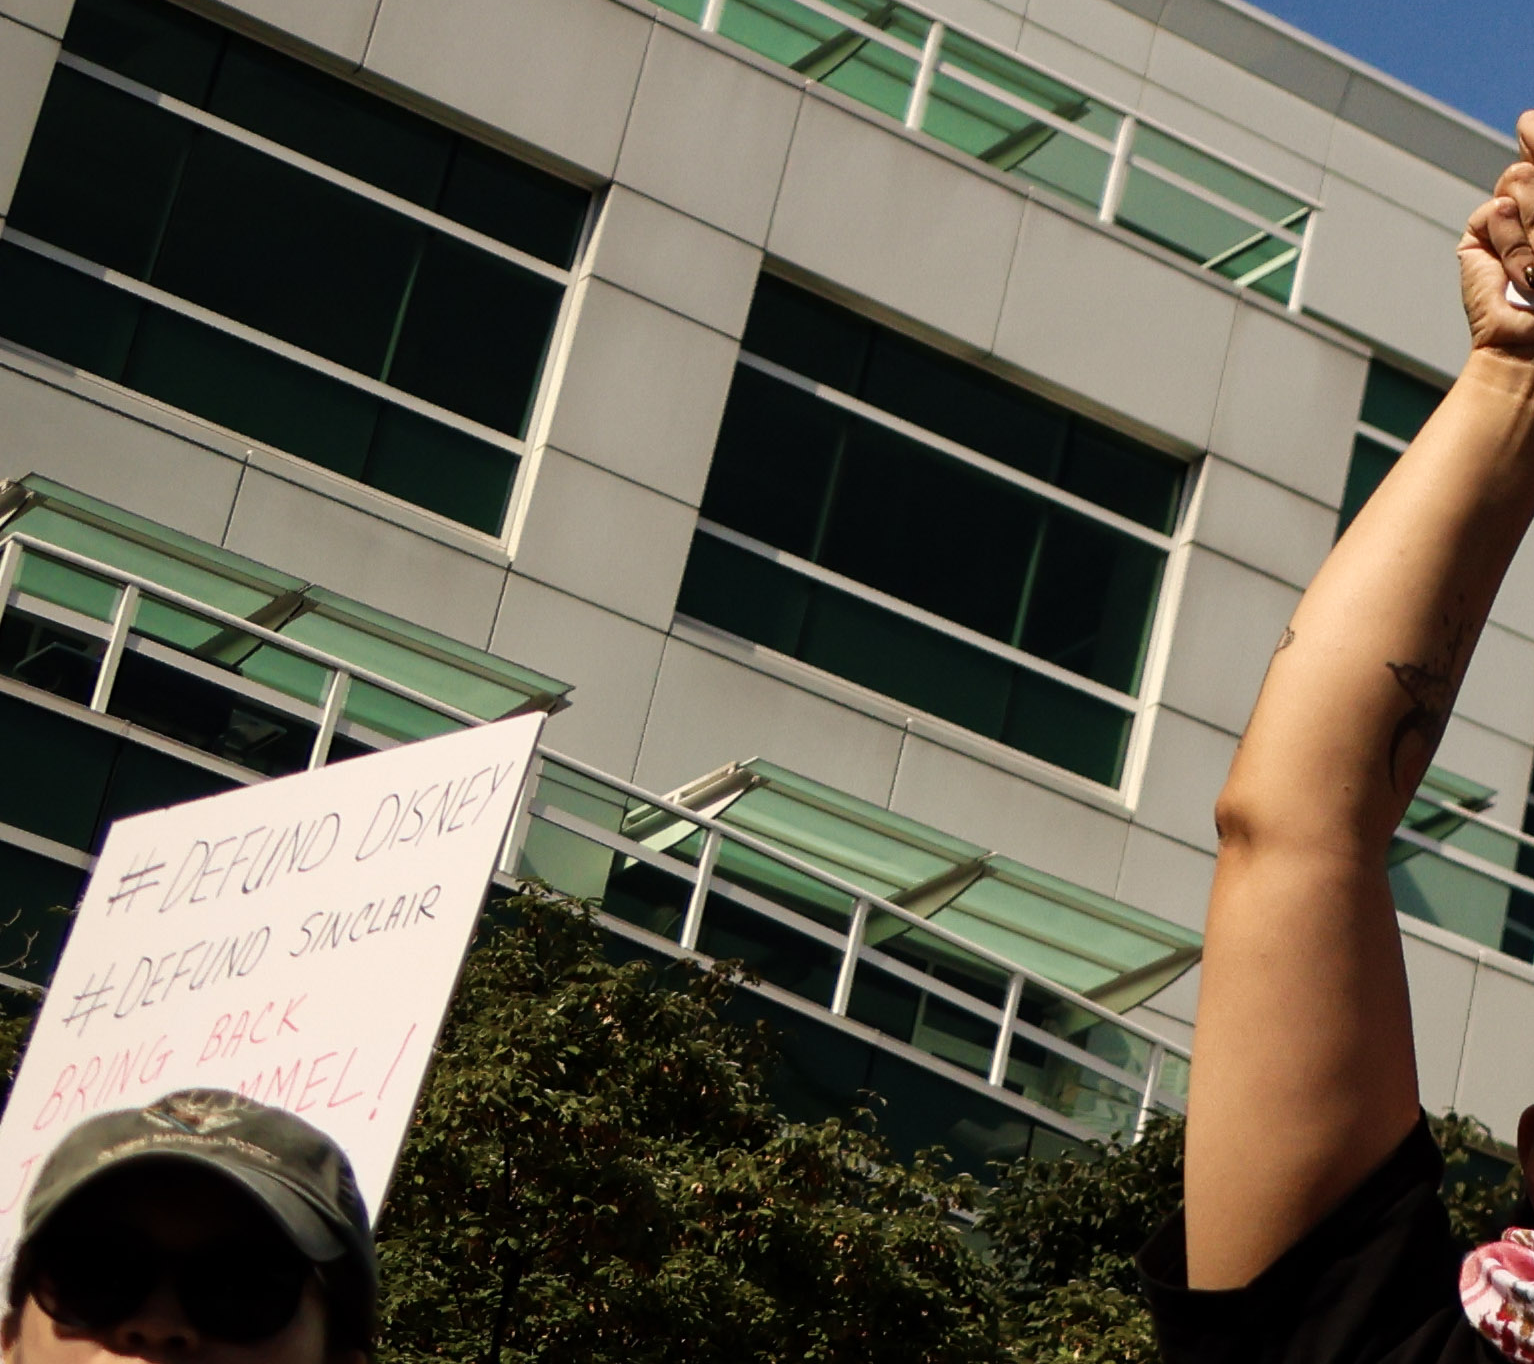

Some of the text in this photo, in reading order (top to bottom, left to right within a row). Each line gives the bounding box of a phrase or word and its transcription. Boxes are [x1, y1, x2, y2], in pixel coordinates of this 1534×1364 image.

[107, 760, 516, 916] #DEFUND DISNEY
[61, 884, 442, 1039] #DEFUND SINCLAIR
[33, 994, 309, 1131] BRING BACK
